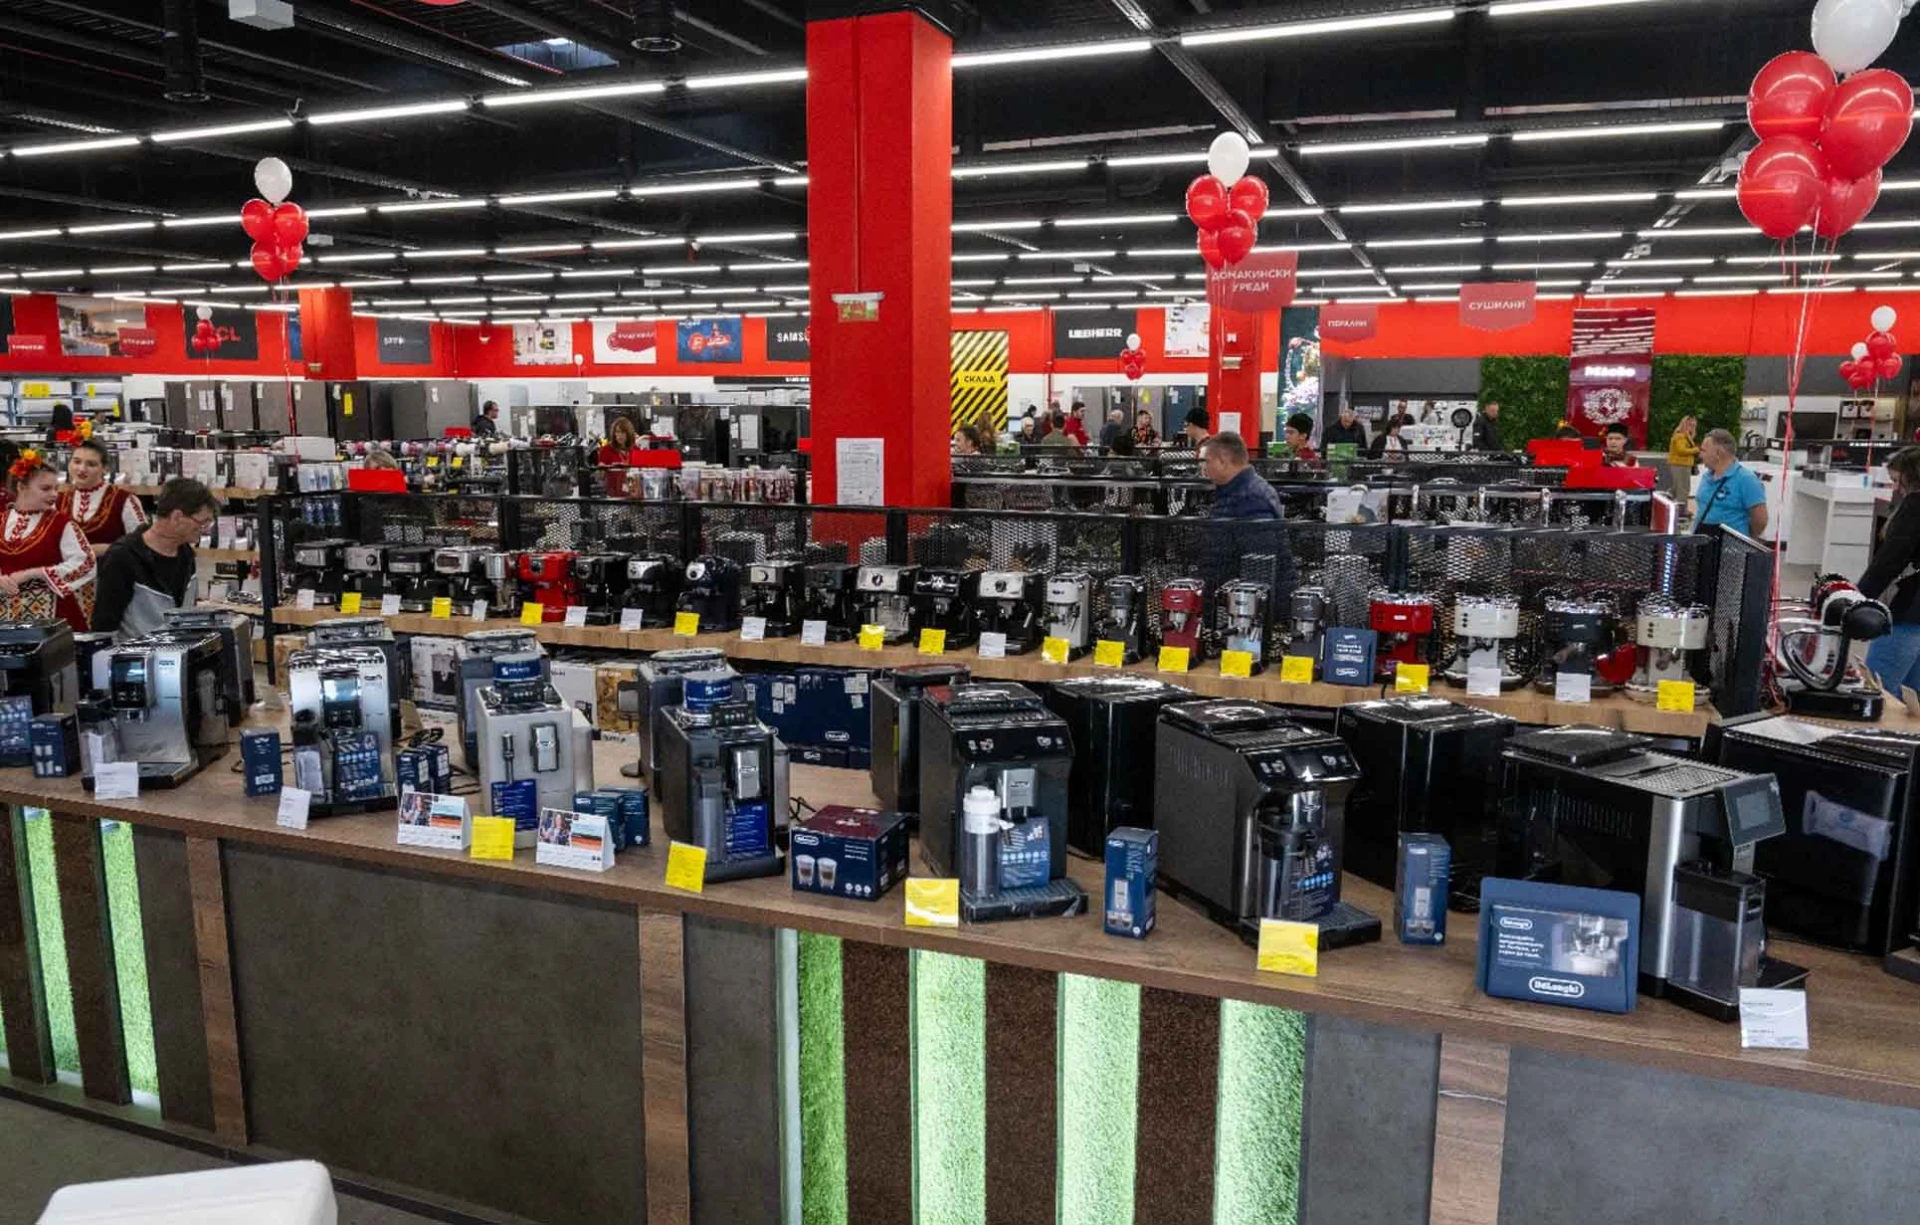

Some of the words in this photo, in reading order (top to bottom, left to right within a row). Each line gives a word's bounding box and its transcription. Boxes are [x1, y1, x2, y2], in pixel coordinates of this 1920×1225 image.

[1232, 281, 1270, 293] УРЕДИ
[1468, 300, 1526, 311] СУШИЛНИ
[1068, 327, 1123, 339] LIEBHERR
[964, 375, 996, 384] СКЛАД
